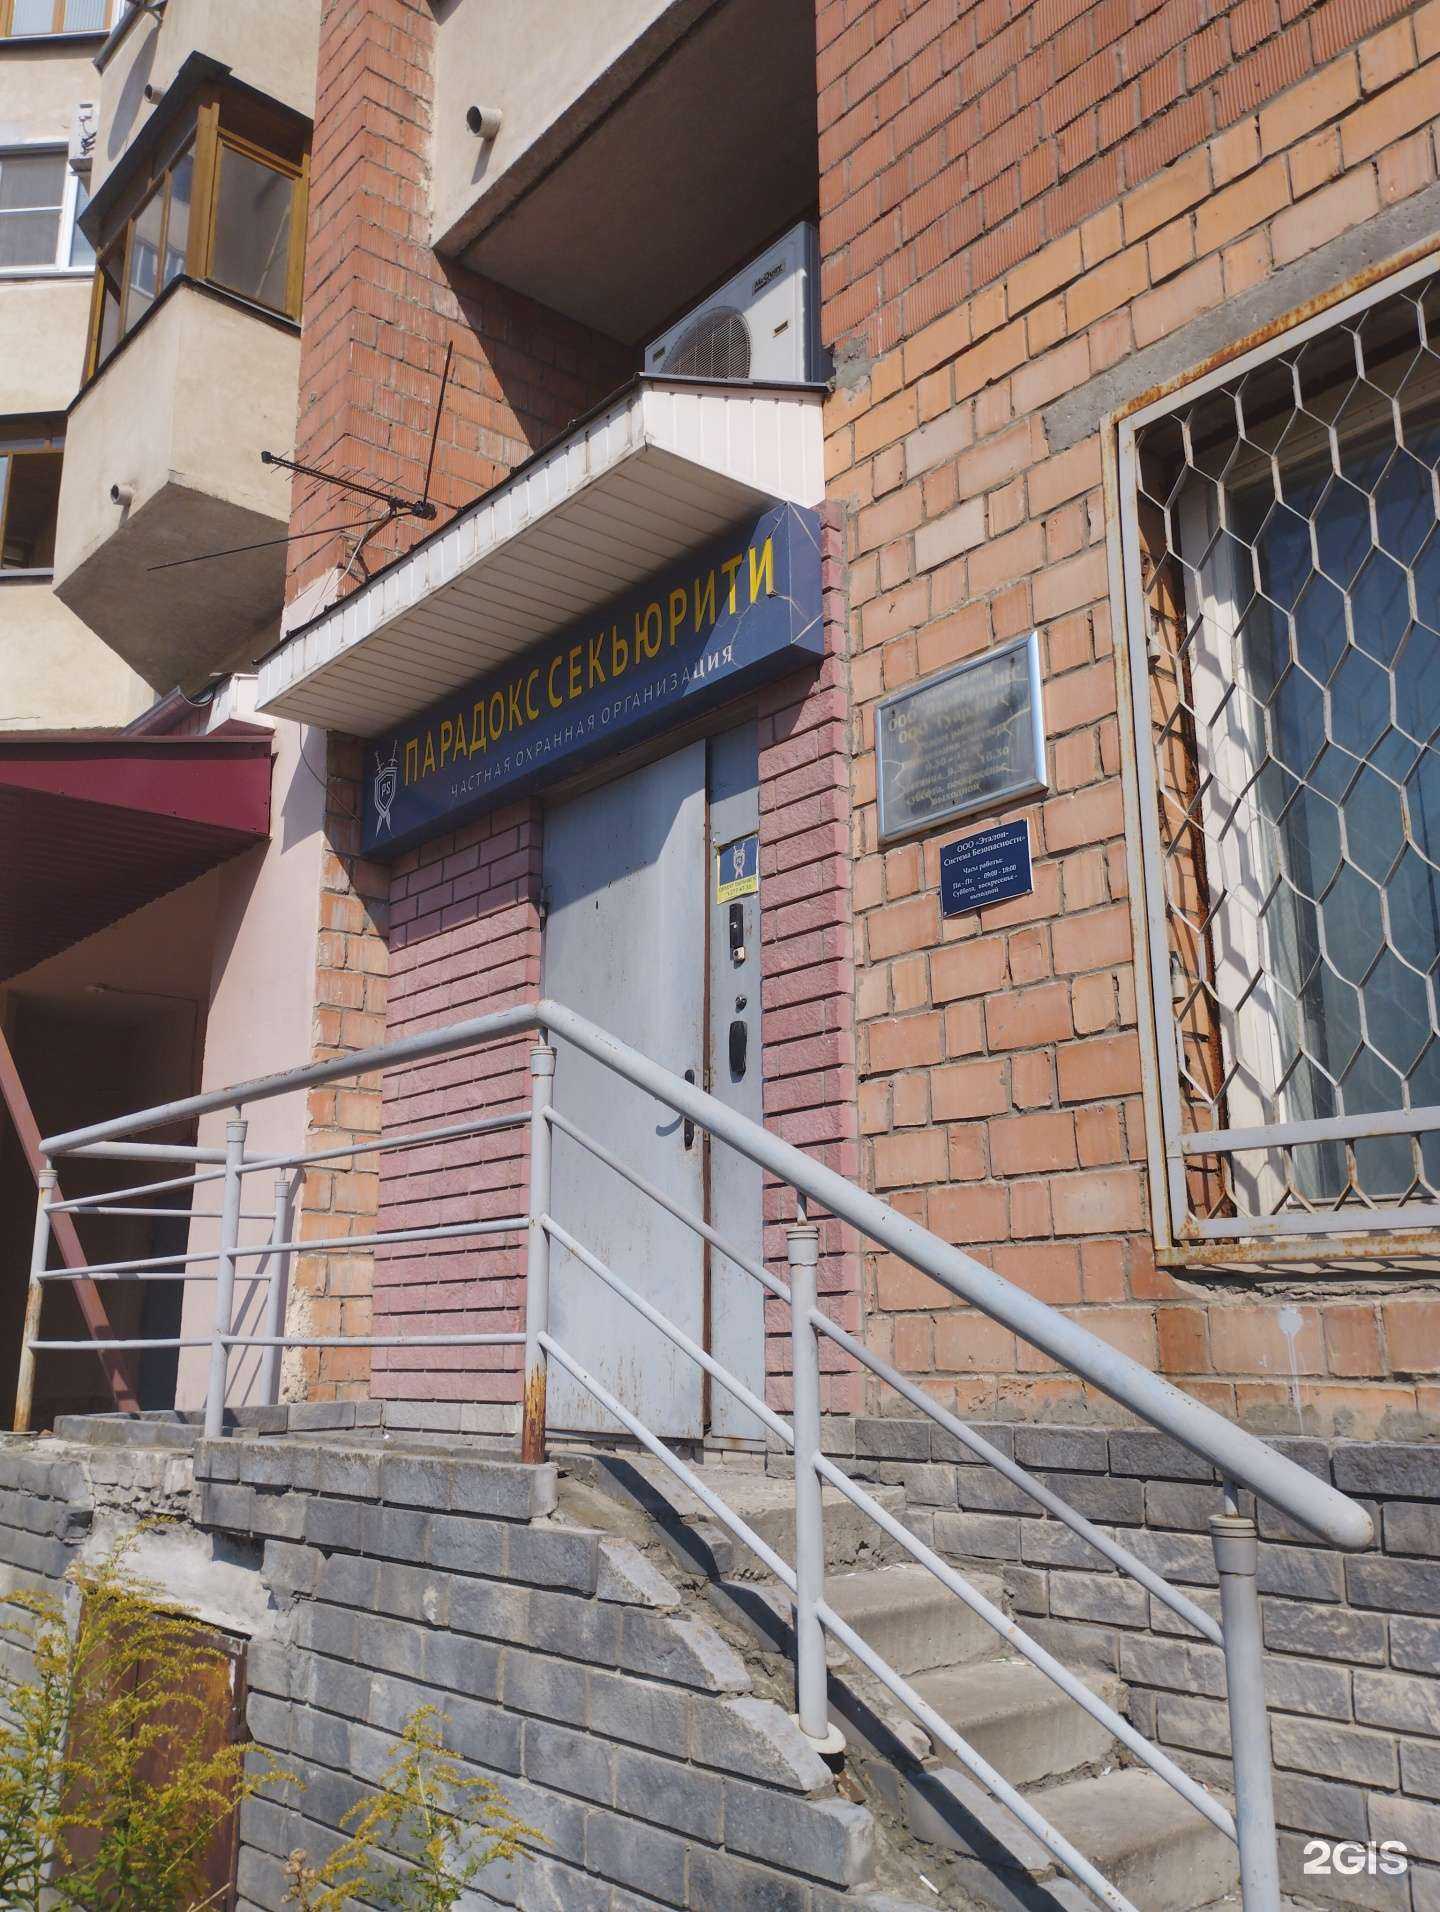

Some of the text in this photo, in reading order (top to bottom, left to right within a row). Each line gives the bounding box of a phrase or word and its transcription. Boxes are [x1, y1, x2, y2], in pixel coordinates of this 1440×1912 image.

[404, 536, 774, 787] ПАРАДОКС СЕКЬЮРИТИ
[451, 644, 733, 798] ЧАСТНАЯ ОХРАННАЯ ОРГАНИЗАЦИЯ
[956, 840, 975, 853] ООО
[943, 853, 971, 867] Система
[963, 865, 978, 874] Часы
